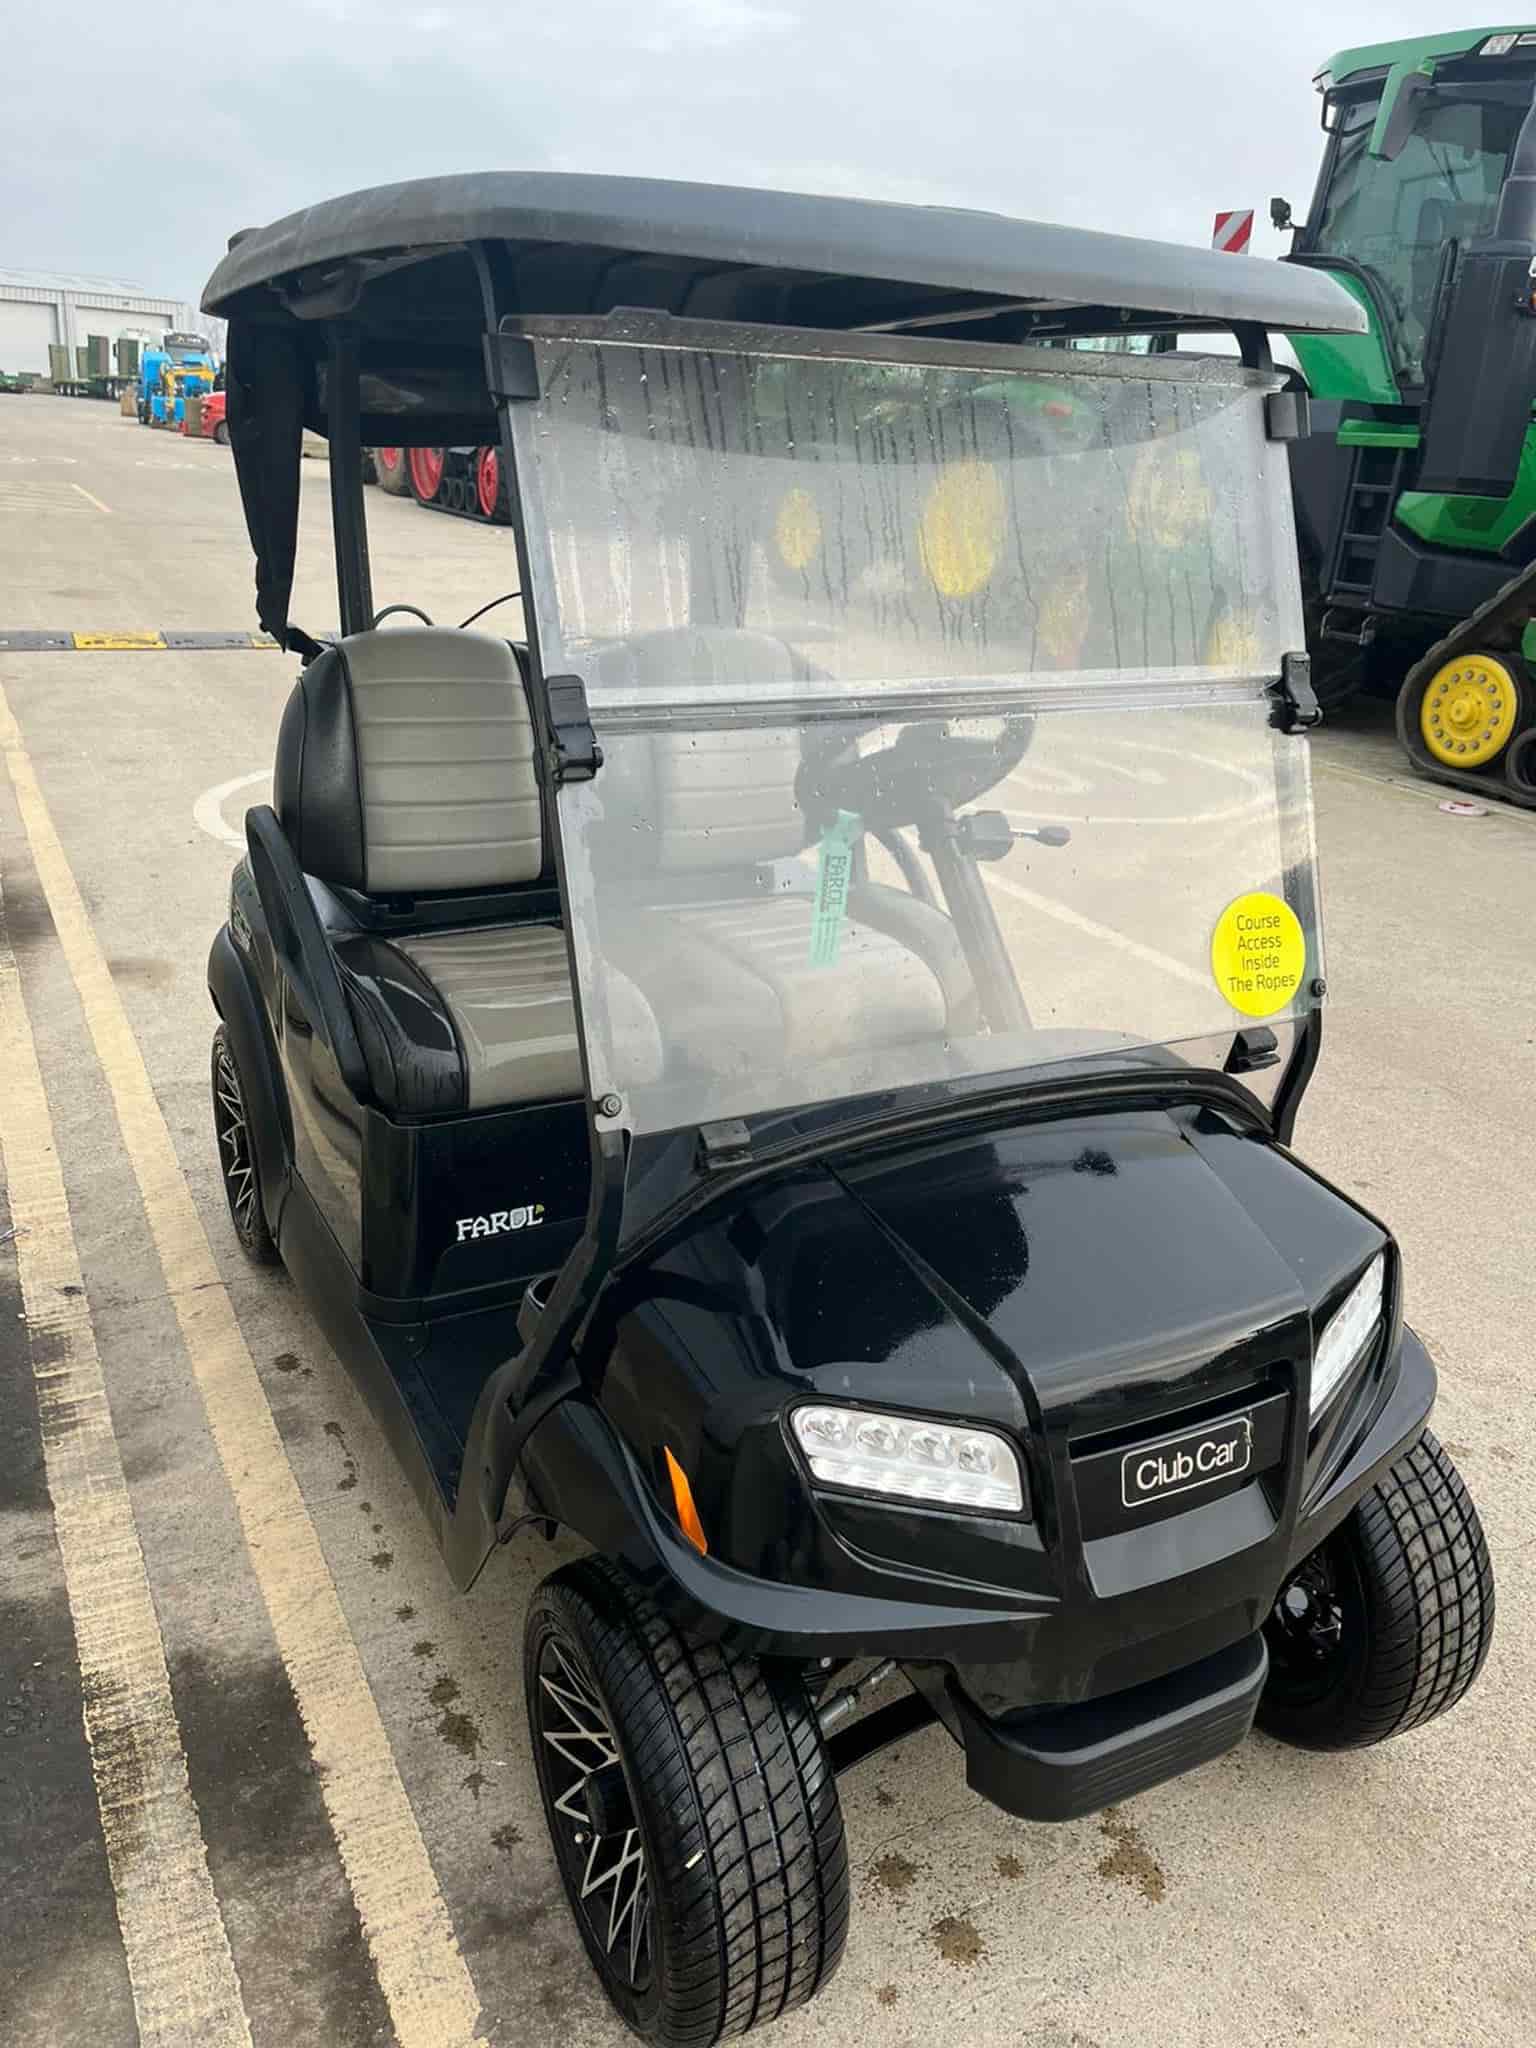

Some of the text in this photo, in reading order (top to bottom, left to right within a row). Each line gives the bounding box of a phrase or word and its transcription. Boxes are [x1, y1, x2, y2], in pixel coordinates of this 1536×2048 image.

[827, 855, 847, 912] FAROL
[1236, 914, 1280, 931] Course
[1238, 935, 1282, 950] Access
[1242, 953, 1280, 970] Inside
[1228, 974, 1296, 992] The Ropes
[456, 1205, 543, 1241] FAROL
[1136, 1440, 1238, 1490] Club Car
